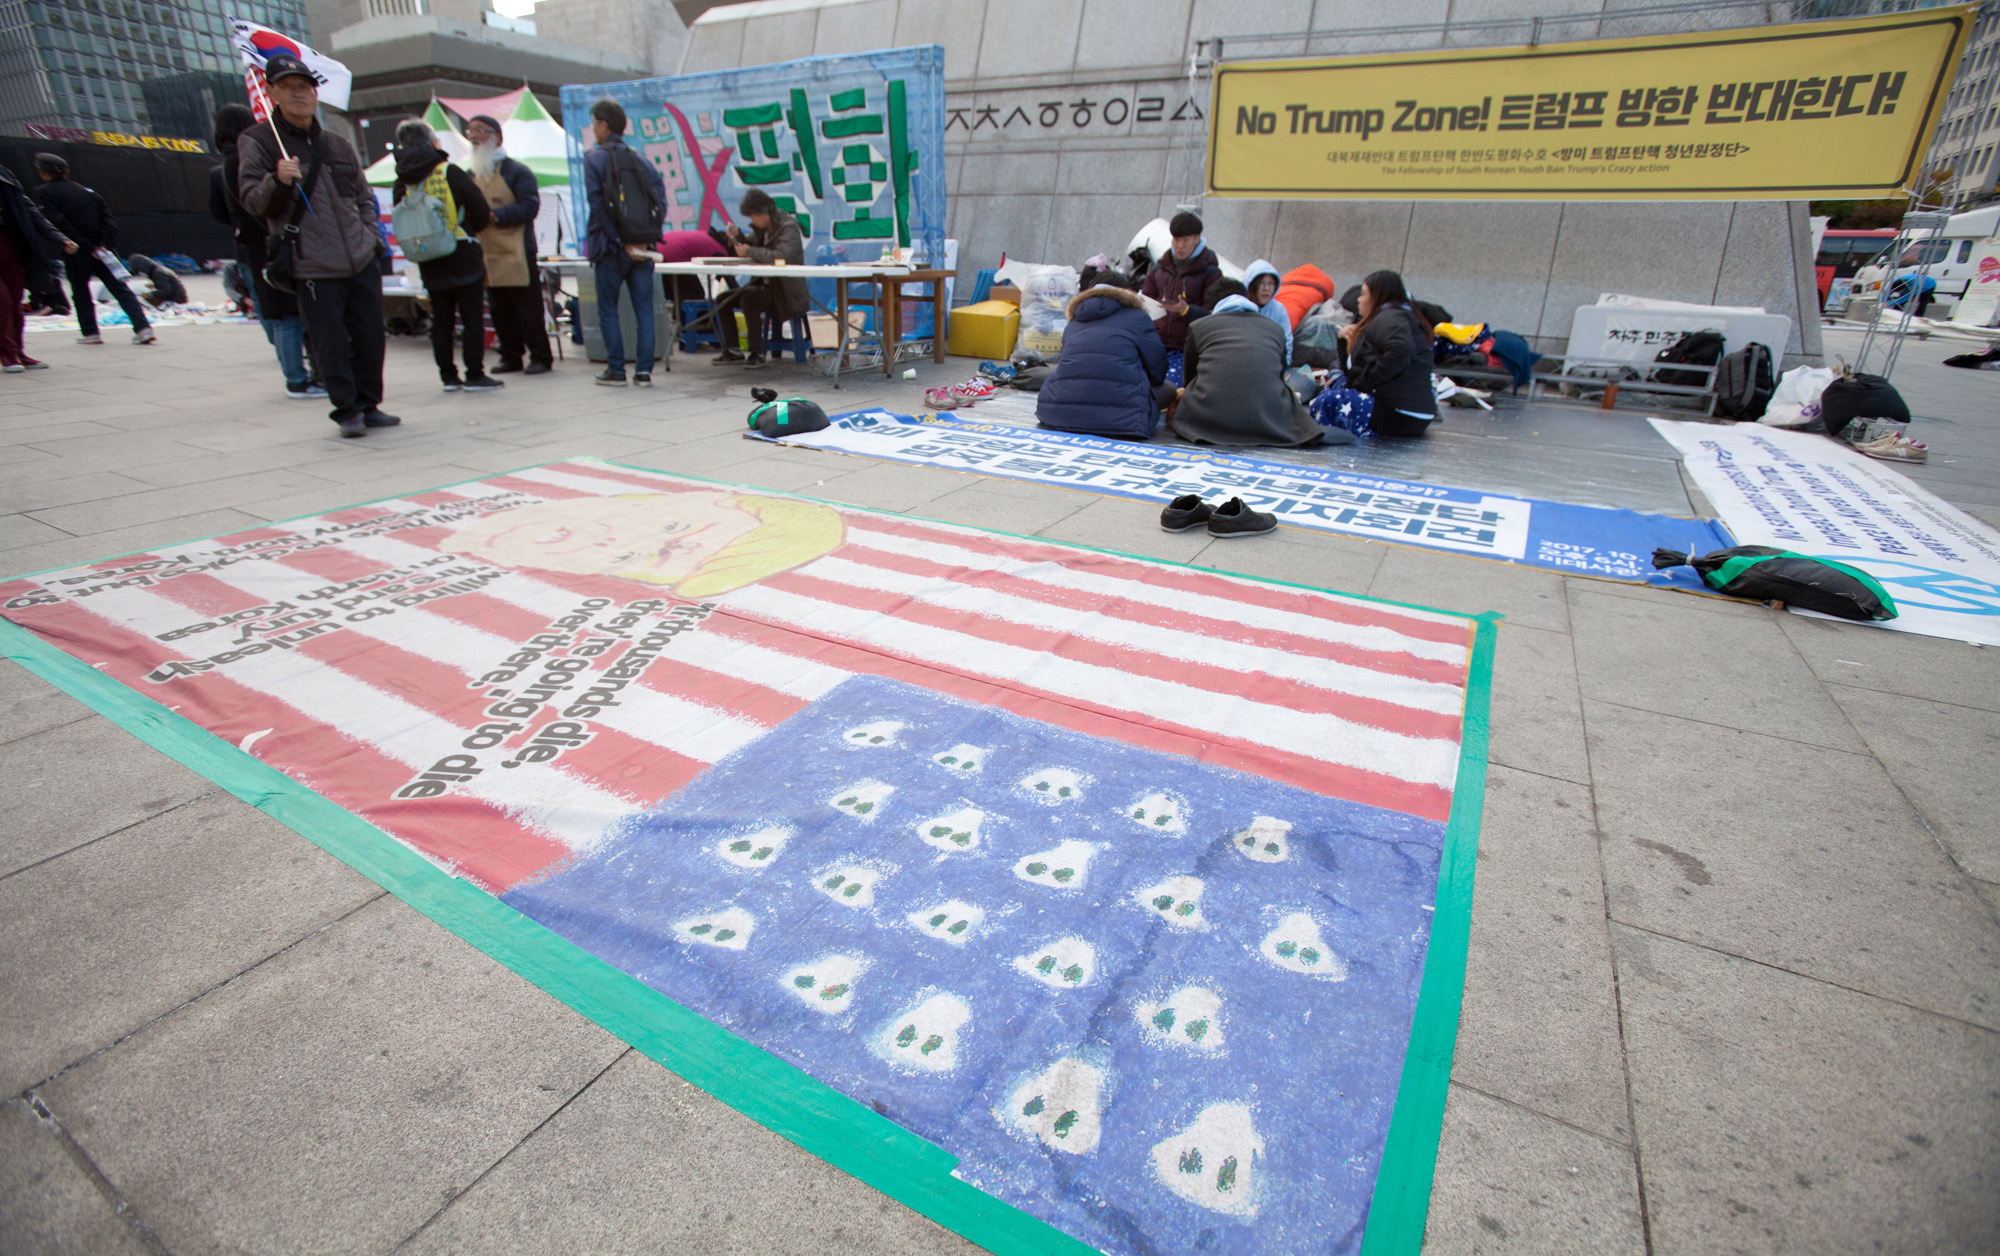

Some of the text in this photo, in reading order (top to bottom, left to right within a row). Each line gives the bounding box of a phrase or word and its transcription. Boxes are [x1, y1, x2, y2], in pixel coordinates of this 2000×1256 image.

[1236, 70, 1908, 141] No Trump Zone! 트럼프 방한 반대한다!
[1382, 166, 1397, 174] The
[1399, 165, 1445, 176] Fellowship
[1446, 166, 1455, 174] of
[1456, 166, 1483, 174] South
[1484, 165, 1516, 174] Korean
[1517, 165, 1545, 174] Youth
[1567, 164, 1606, 175] Trump's
[1608, 163, 1635, 175] Crazy
[1637, 163, 1670, 173] action
[1397, 149, 1457, 163] 트럼프탄핵
[1590, 145, 1662, 160] 트럼프탄핵
[1113, 443, 1167, 457] 미국?
[1257, 465, 1330, 481] 무엇이
[1333, 475, 1449, 497] 두려운가?
[994, 457, 1106, 481] 불허
[1231, 491, 1496, 547] 기자회견
[1200, 469, 1505, 527] 청년원정단
[295, 537, 343, 551] no
[1538, 546, 1588, 560] 오후
[1538, 553, 1641, 577] 미대사관
[6, 594, 64, 609] to
[66, 574, 155, 598] but
[331, 583, 410, 611] and
[154, 600, 299, 642] Korea
[345, 606, 396, 623] to
[549, 598, 611, 633] over
[147, 622, 345, 682] unleash
[563, 619, 695, 719] thousands
[489, 658, 636, 719] going
[462, 723, 524, 750] to
[397, 754, 485, 799] die
